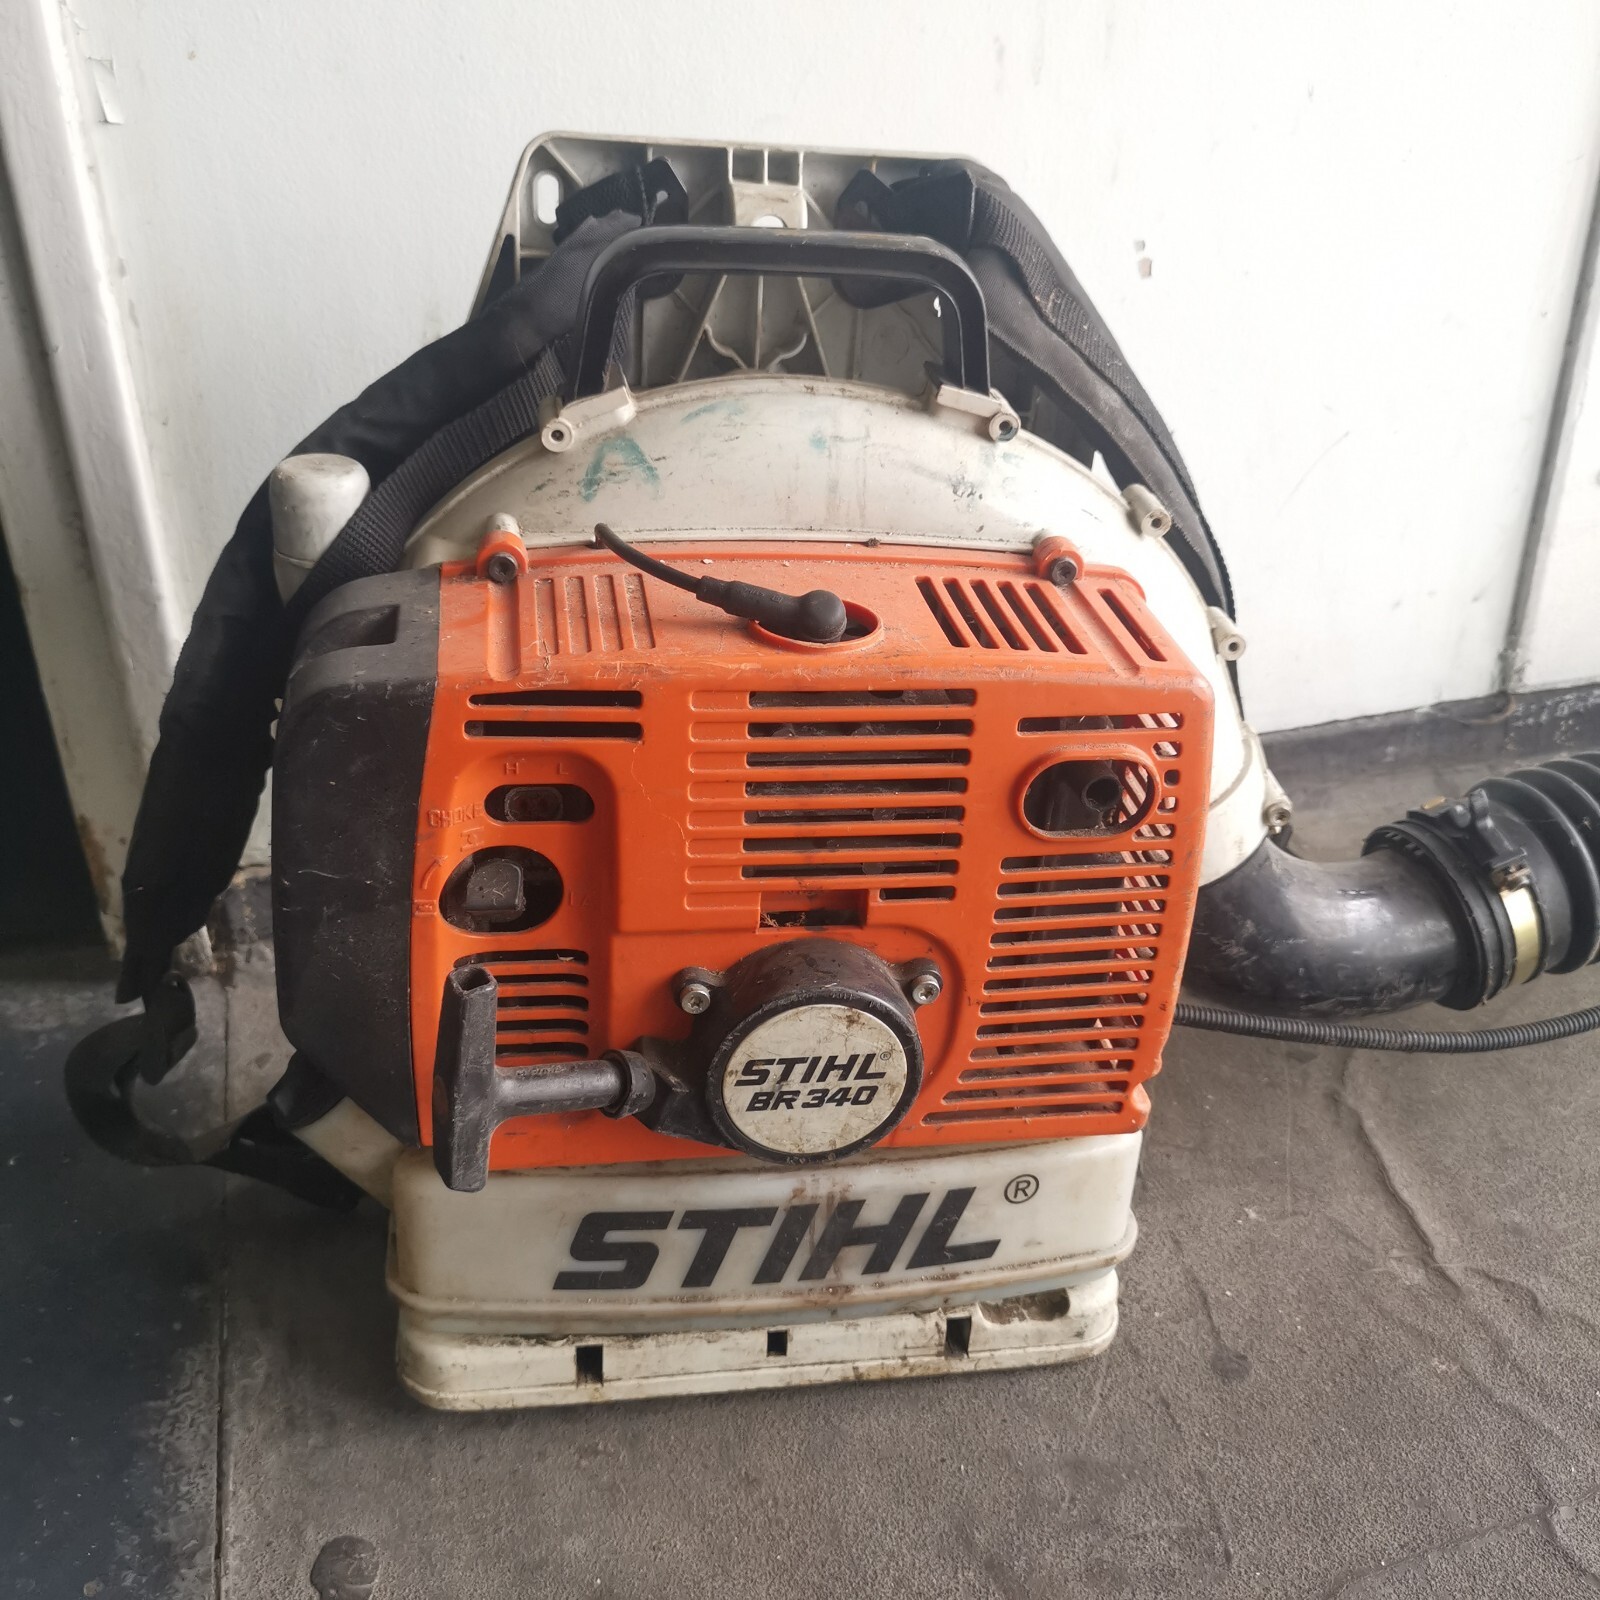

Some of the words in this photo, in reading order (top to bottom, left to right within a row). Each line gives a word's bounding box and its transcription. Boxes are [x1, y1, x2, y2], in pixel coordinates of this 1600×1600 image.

[504, 762, 520, 776] H
[557, 763, 569, 775] L
[427, 803, 485, 828] CHOKE
[734, 1053, 888, 1087] STIHL
[745, 1090, 801, 1112] BR
[801, 1085, 879, 1109] 340
[553, 1186, 1002, 1291] STIHL
